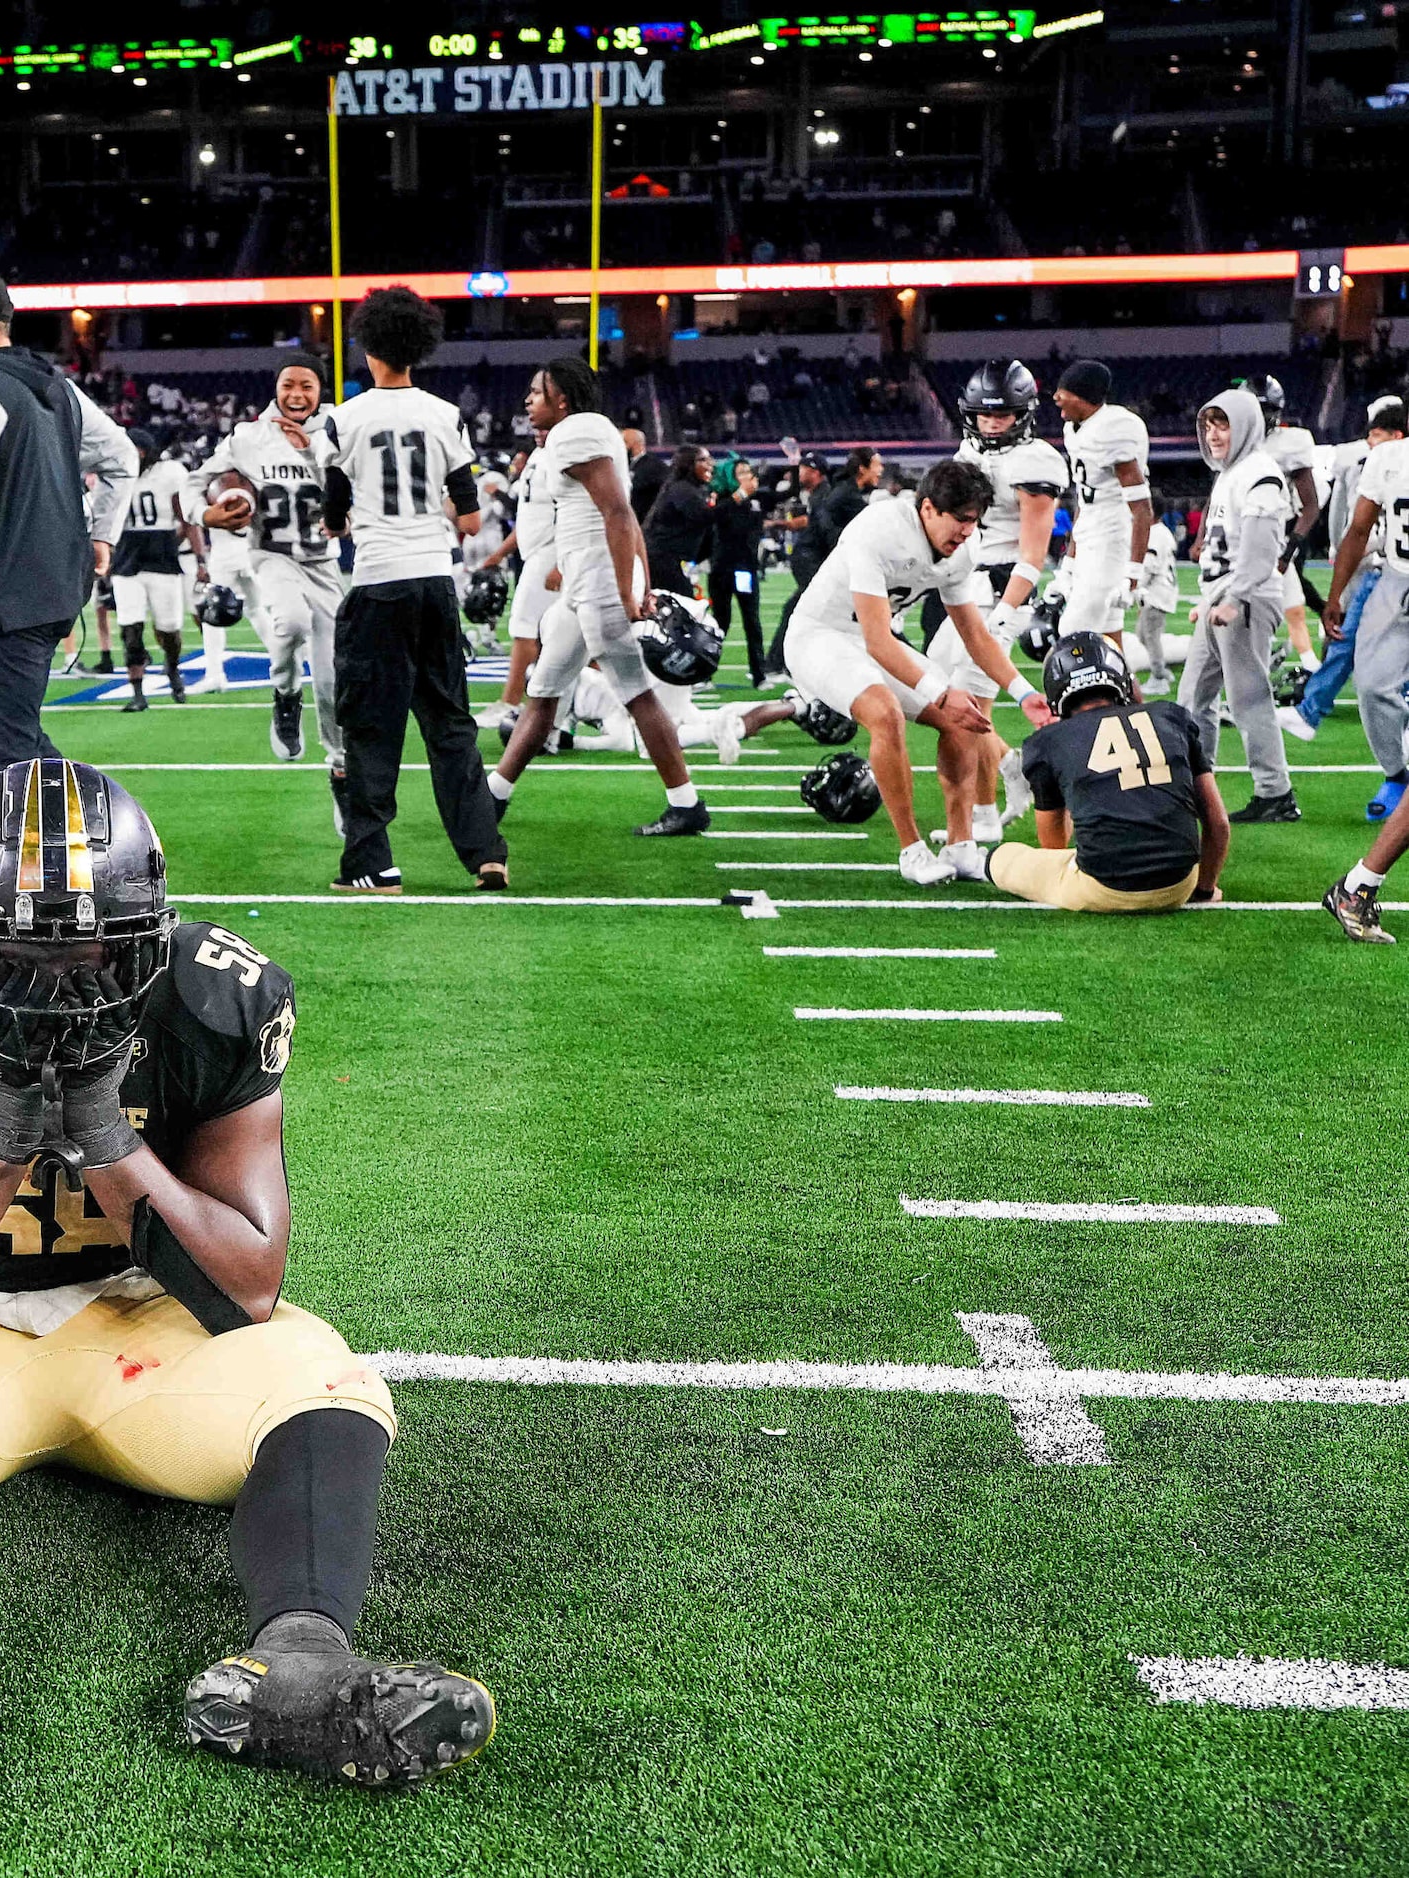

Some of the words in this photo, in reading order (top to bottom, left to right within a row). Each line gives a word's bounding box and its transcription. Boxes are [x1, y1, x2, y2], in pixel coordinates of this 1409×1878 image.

[429, 33, 477, 57] 0:00
[613, 26, 641, 49] 35
[330, 68, 443, 116] AT&T
[453, 60, 665, 112] STADIUM
[370, 430, 428, 516] 11
[1088, 711, 1173, 791] 41
[193, 927, 271, 987] 58
